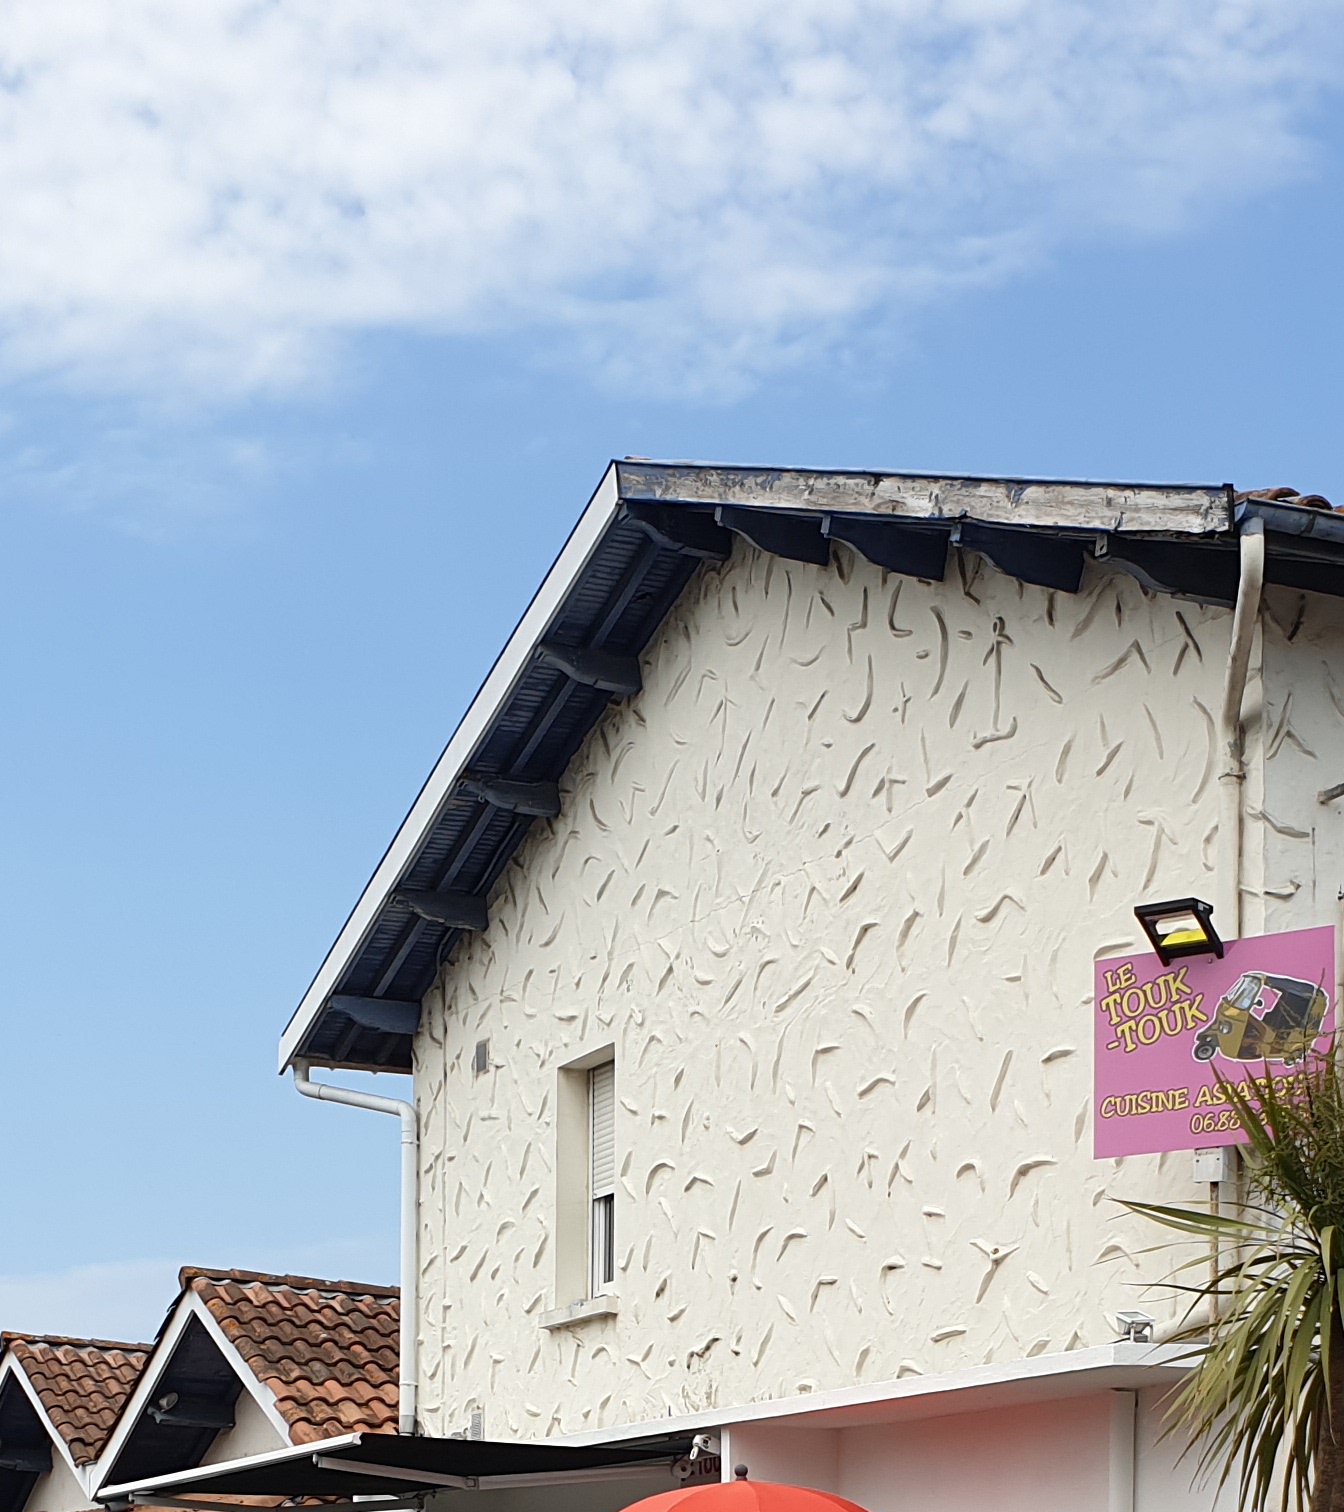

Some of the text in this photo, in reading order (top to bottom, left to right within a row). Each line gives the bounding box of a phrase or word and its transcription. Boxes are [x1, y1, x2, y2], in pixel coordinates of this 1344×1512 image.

[1103, 962, 1137, 993] LE
[1100, 966, 1193, 1025] TOUK
[1100, 1088, 1190, 1119] CUISINE
